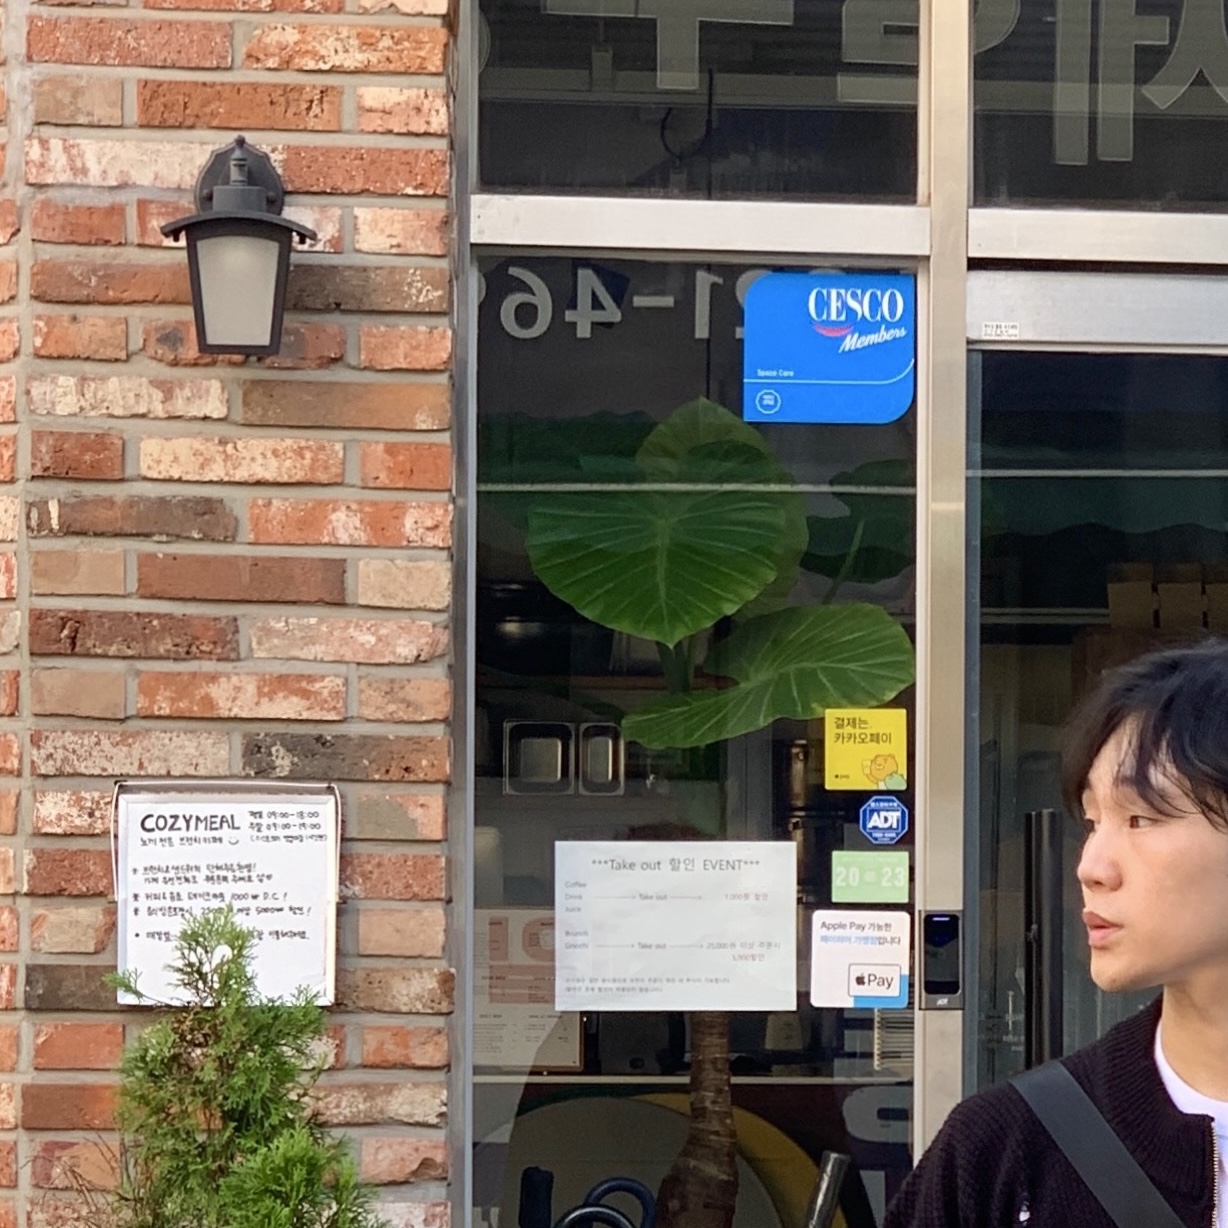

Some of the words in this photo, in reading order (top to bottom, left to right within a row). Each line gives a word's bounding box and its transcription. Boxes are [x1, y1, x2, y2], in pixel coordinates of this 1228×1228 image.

[808, 287, 904, 323] CESCO
[838, 325, 907, 353] Members
[833, 716, 870, 731] 결제는
[833, 732, 892, 745] 카카오페이
[140, 813, 241, 832] COZYMEAL
[867, 811, 902, 829] ADT
[640, 861, 661, 871] out
[669, 858, 695, 872] 할인
[820, 922, 847, 931] Apple
[850, 922, 866, 931] Pay
[867, 974, 894, 989] Pay
